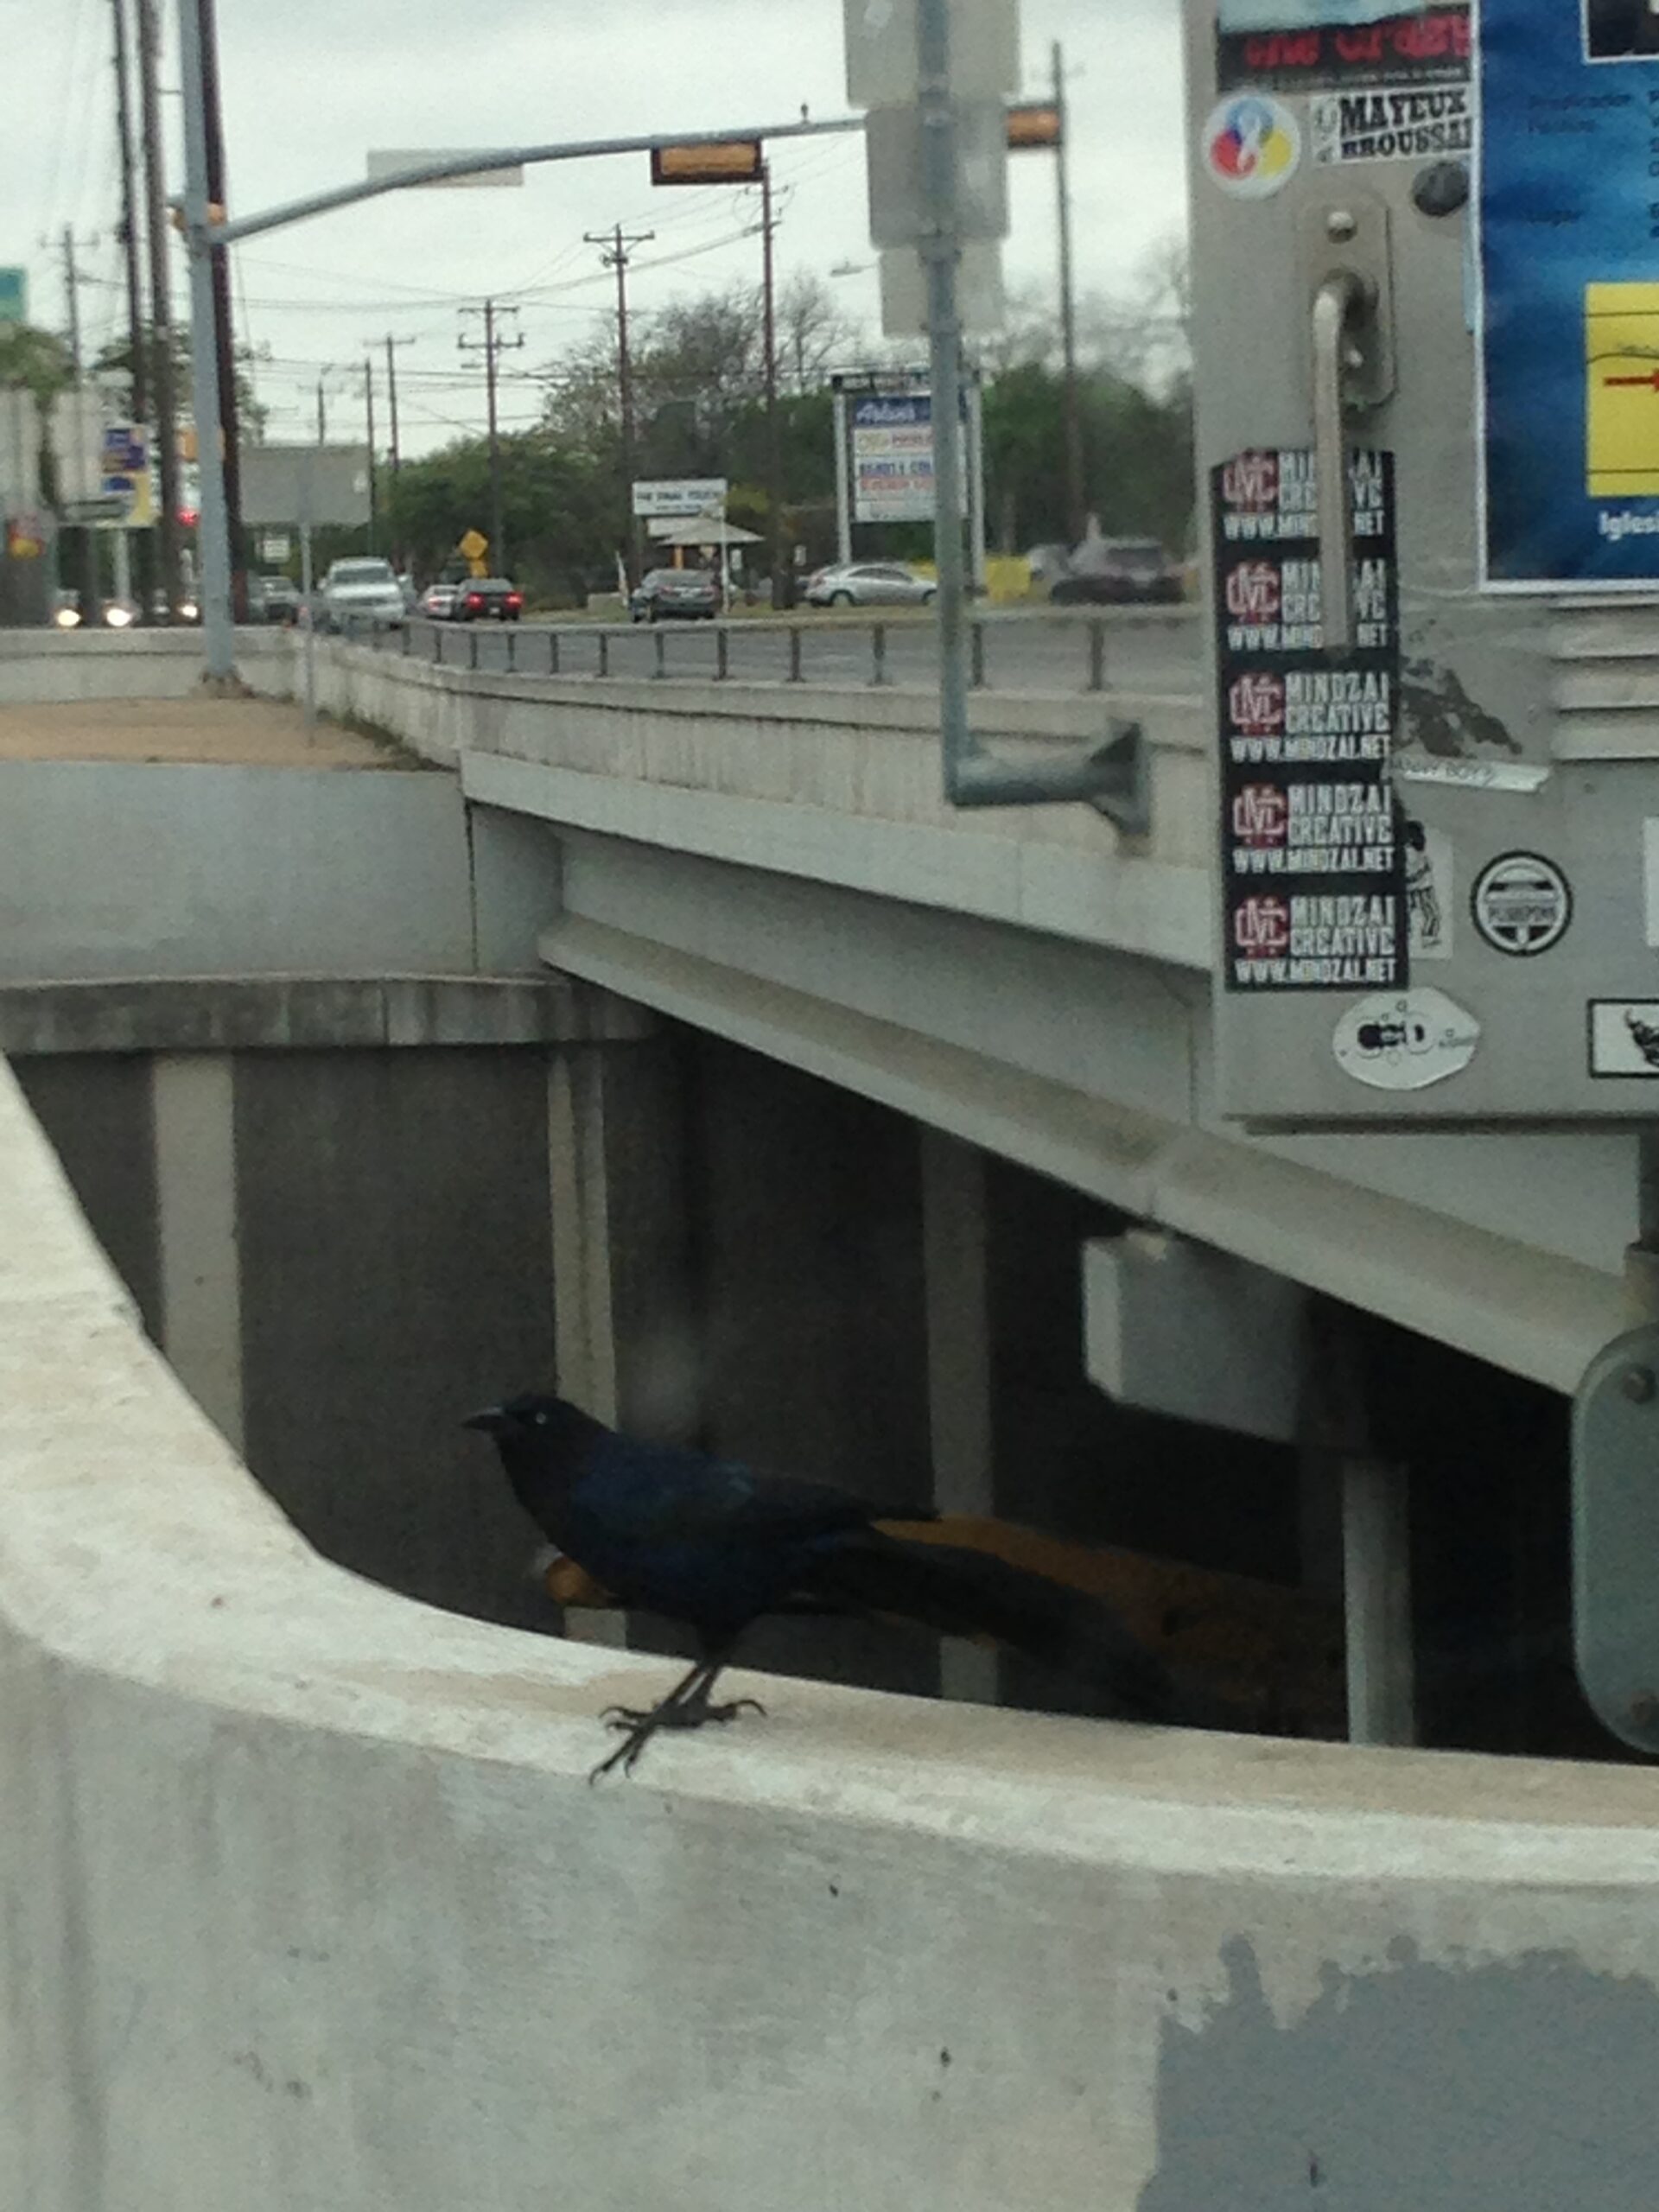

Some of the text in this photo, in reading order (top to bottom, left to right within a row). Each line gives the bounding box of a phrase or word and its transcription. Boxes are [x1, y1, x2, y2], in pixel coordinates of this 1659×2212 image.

[1339, 89, 1466, 137] MAYEUX
[1285, 671, 1389, 702] MINDZAI
[1286, 704, 1390, 734] CREATIVE
[1230, 735, 1390, 763] WWW.MINDZAI.NET
[1287, 785, 1390, 815] MINDZAI
[1288, 815, 1392, 845] CREATIVE
[1233, 847, 1394, 874] WWW.MINDZAI.NET
[1290, 895, 1395, 925] MINDZAI
[1290, 927, 1395, 956] CREATIVE
[1235, 958, 1395, 984] WWW.MINDZAI.NET
